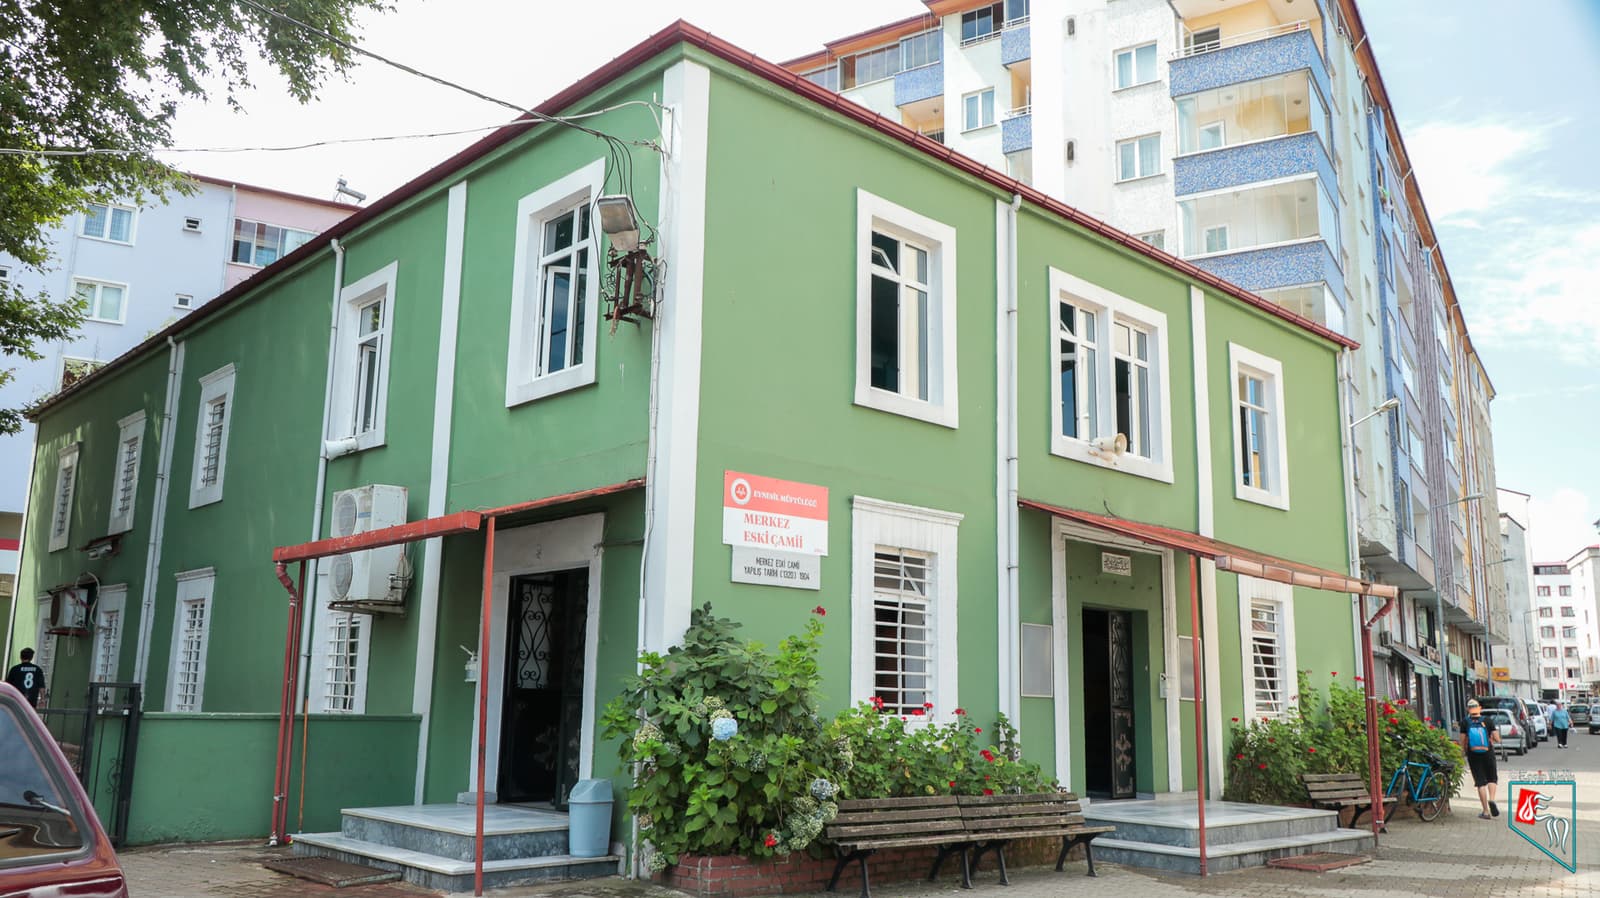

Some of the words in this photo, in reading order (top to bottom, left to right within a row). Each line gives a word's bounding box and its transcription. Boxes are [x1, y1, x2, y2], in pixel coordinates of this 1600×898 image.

[744, 513, 790, 529] MERKEZ
[744, 530, 769, 544] ESKİ
[24, 672, 34, 689] 8
